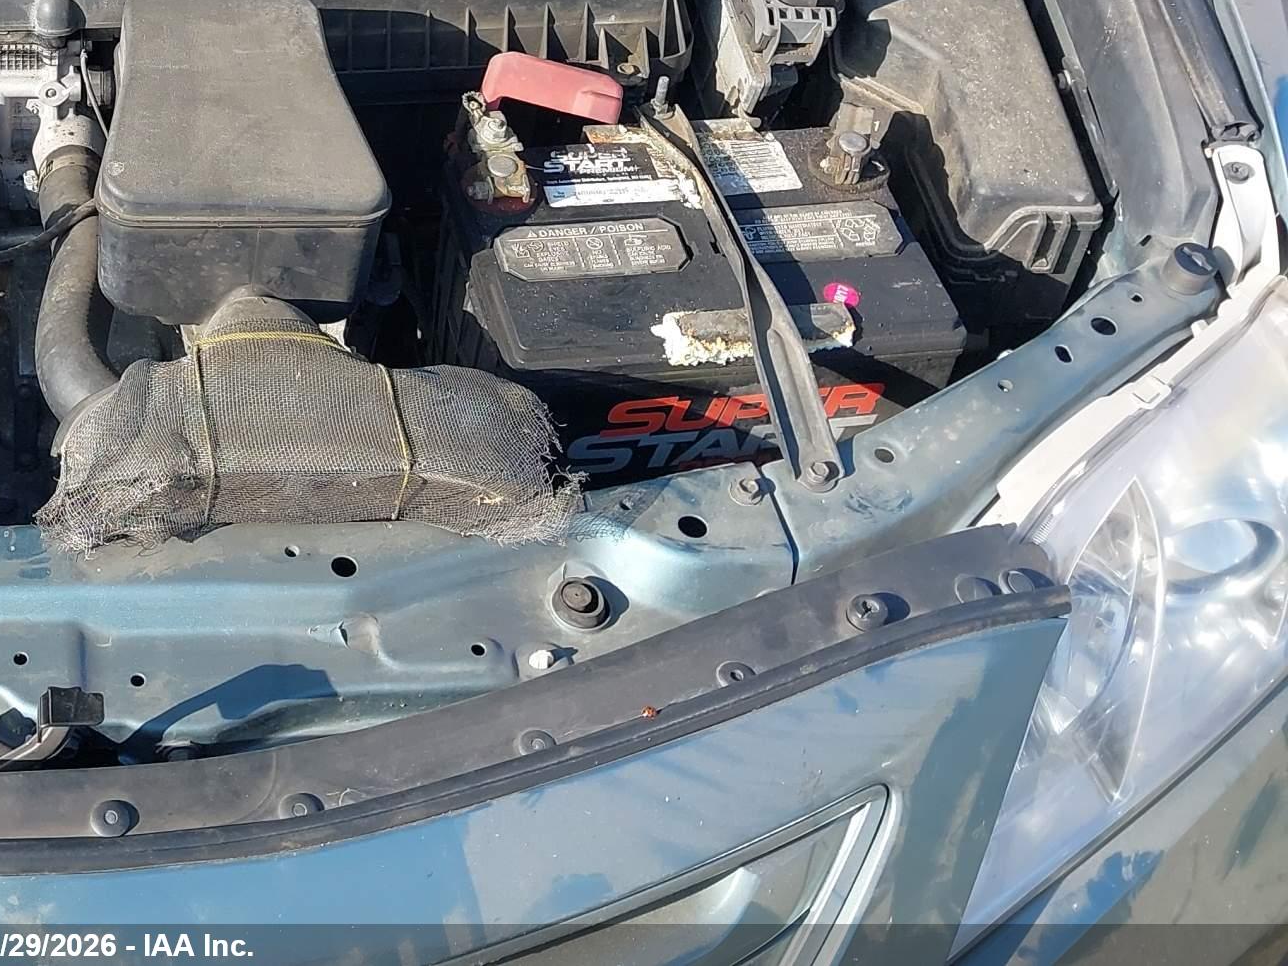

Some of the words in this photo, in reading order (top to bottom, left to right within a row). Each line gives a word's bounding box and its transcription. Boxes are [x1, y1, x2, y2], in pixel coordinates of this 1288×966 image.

[543, 158, 631, 173] START
[538, 228, 588, 238] DANGER
[599, 223, 645, 234] POISON
[600, 384, 885, 436] SUPR
